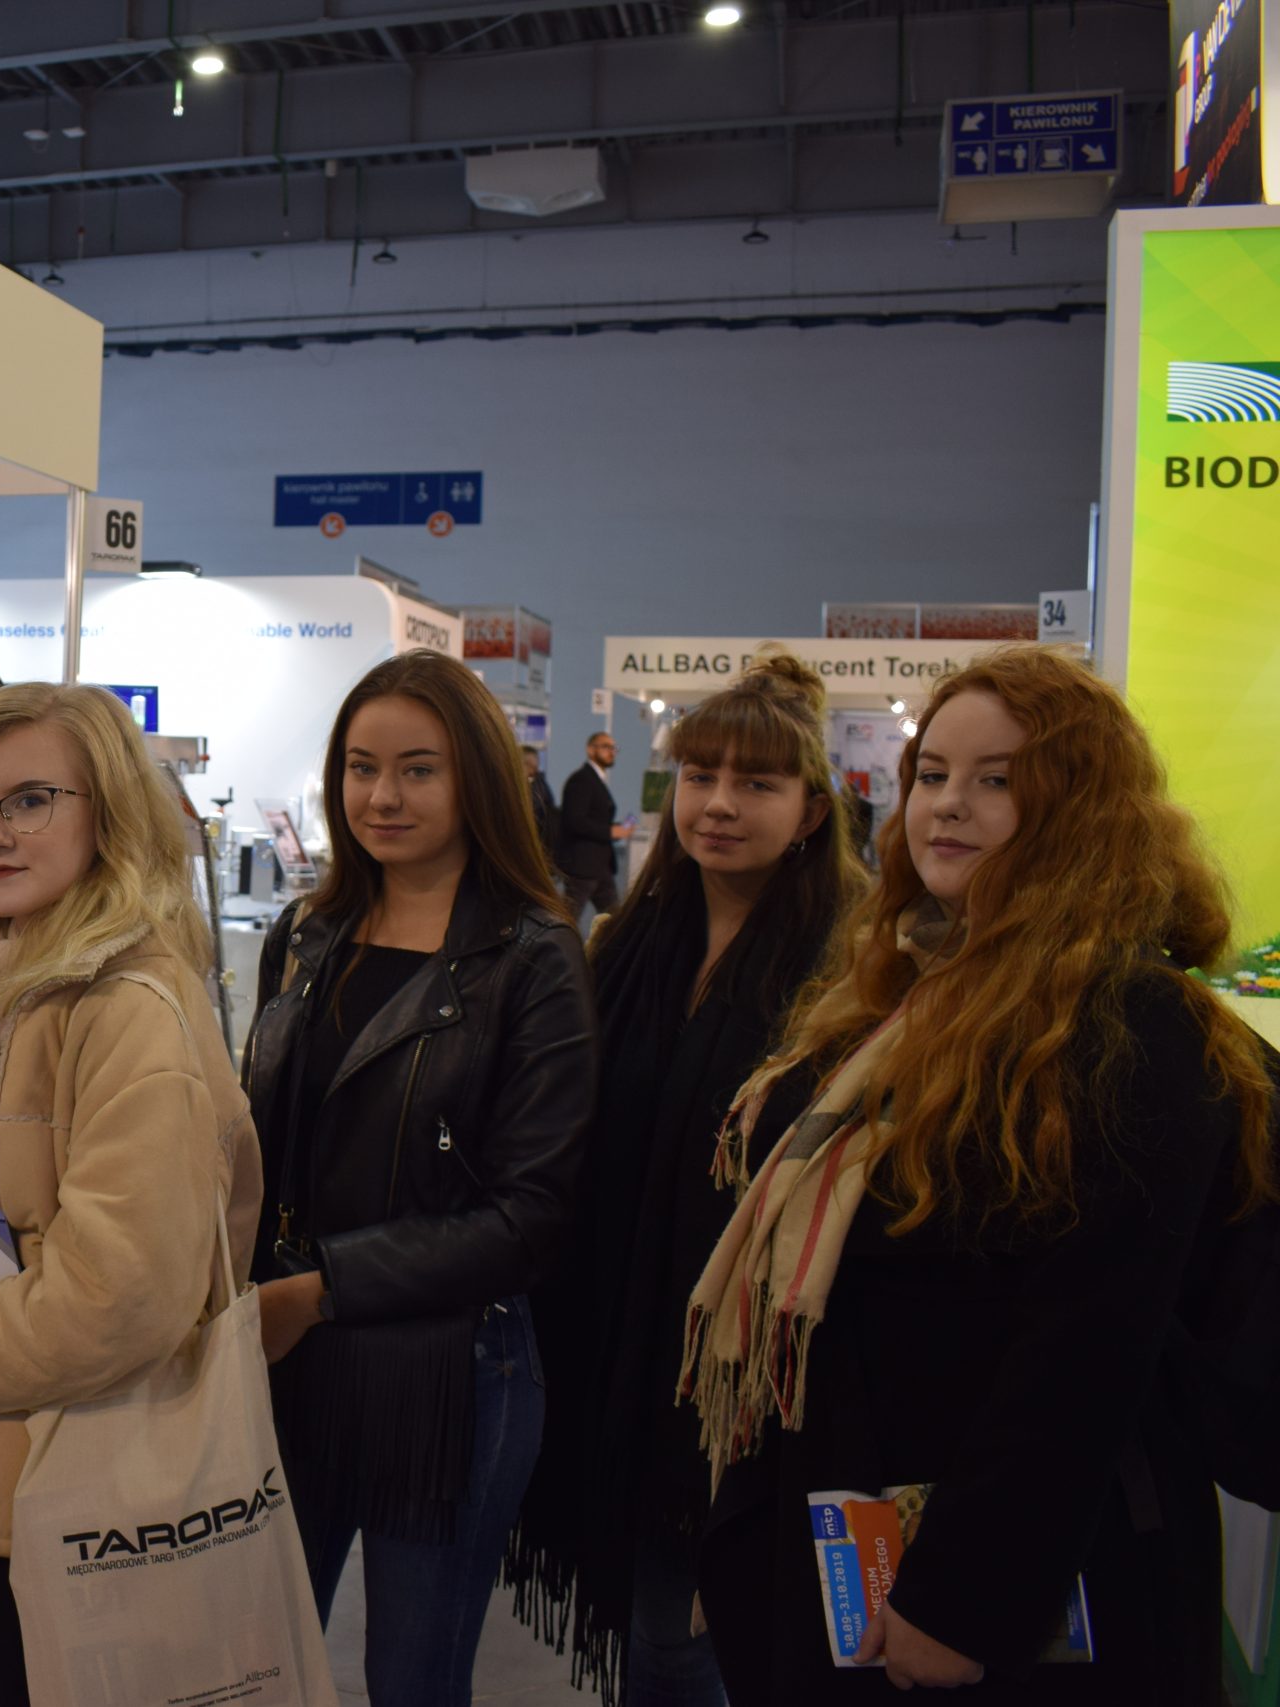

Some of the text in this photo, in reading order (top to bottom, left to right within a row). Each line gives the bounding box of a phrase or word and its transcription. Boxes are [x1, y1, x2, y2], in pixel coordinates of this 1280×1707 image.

[1009, 101, 1099, 118] KIEROWNIK
[1012, 115, 1095, 131] PAWILONU
[1165, 456, 1280, 489] BIOD
[106, 509, 137, 550] 66
[1043, 598, 1066, 627] 34
[298, 621, 353, 638] World
[622, 653, 958, 678] ALLBAG Pucent Toreb
[63, 1467, 282, 1561] TAROPAK
[823, 1507, 835, 1537] mtp
[67, 1523, 261, 1577] MIĘDZYNARODOWE TARGI TECHNIKI PAKOWANIA
[832, 1552, 856, 1649] 30.09-3.10.2019
[866, 1567, 883, 1615] MECUM
[244, 1666, 280, 1685] Allbag
